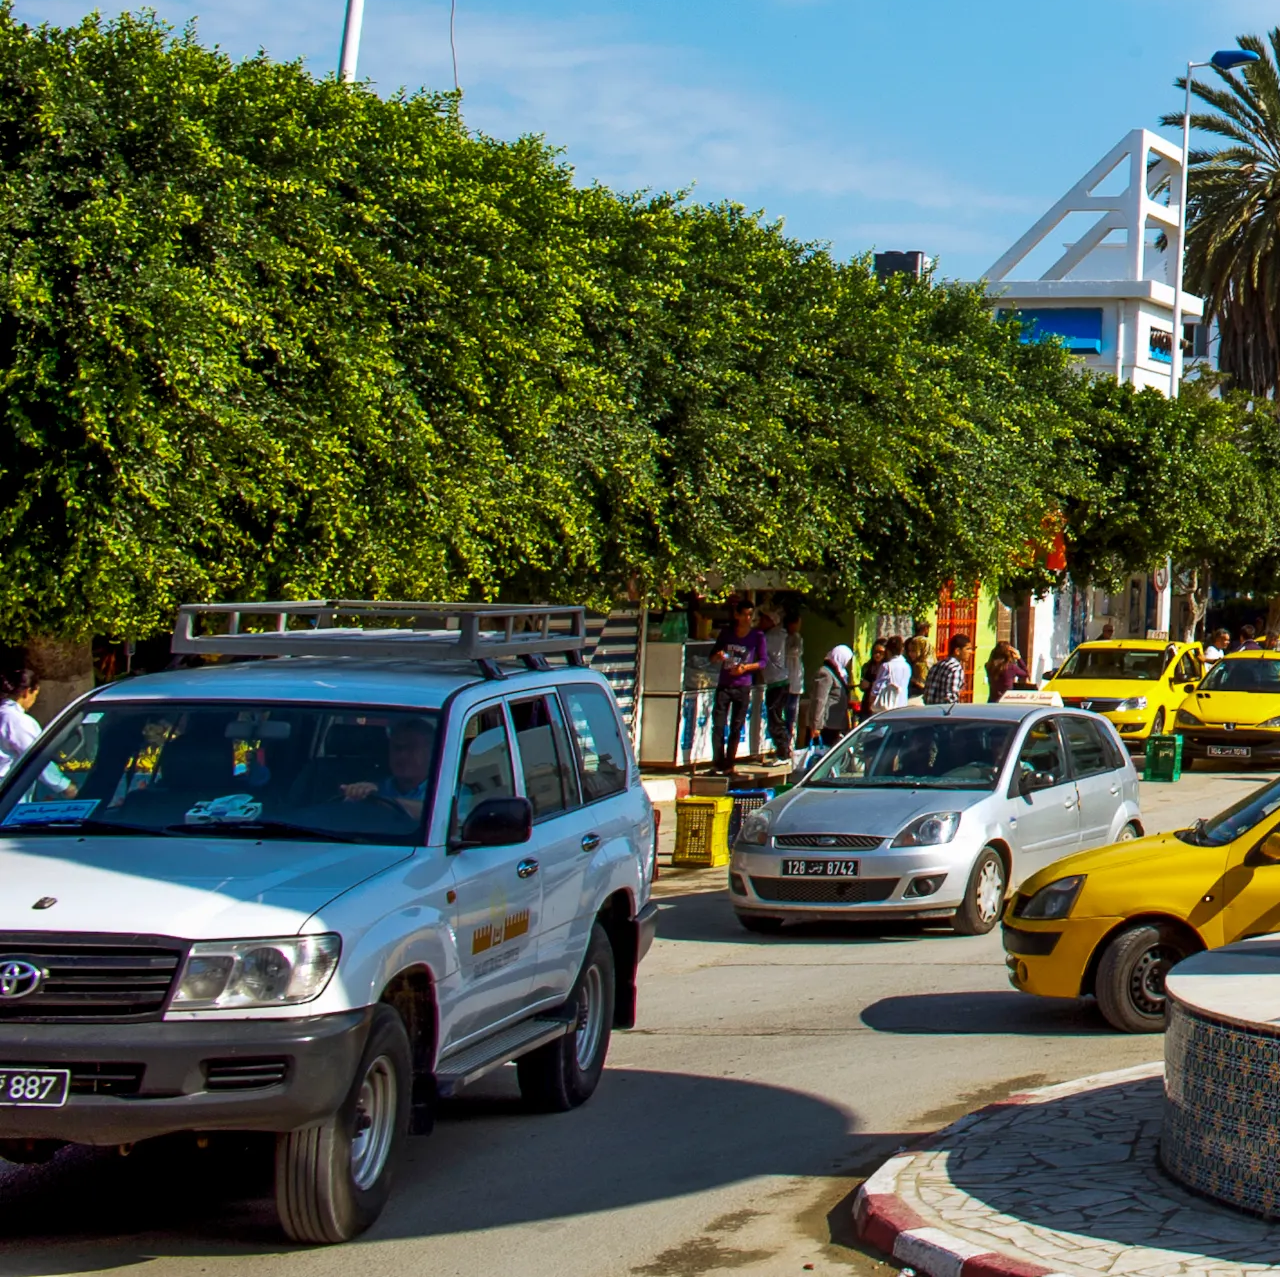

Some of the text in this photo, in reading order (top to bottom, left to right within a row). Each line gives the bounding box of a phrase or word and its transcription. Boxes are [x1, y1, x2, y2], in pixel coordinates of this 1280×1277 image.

[788, 861, 805, 874] 128
[827, 861, 855, 875] 8742
[9, 1075, 57, 1100] 887
